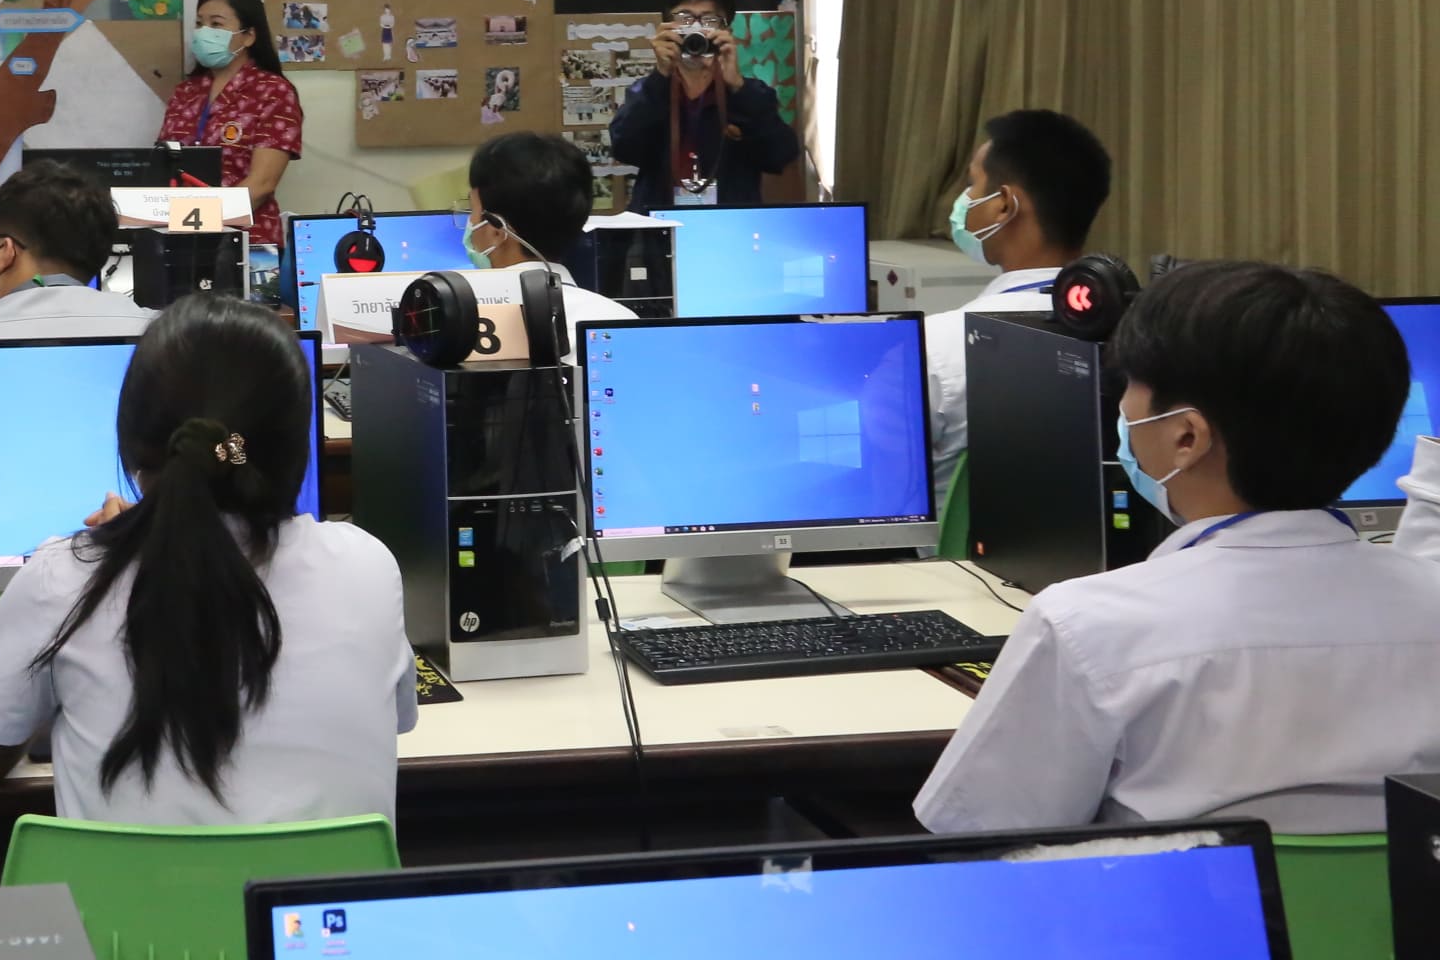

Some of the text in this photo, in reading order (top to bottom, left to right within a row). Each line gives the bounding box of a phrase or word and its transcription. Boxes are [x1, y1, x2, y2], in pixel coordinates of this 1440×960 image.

[182, 208, 203, 230] 4
[472, 317, 502, 355] 8
[462, 612, 479, 632] hp
[326, 913, 344, 928] Ps
